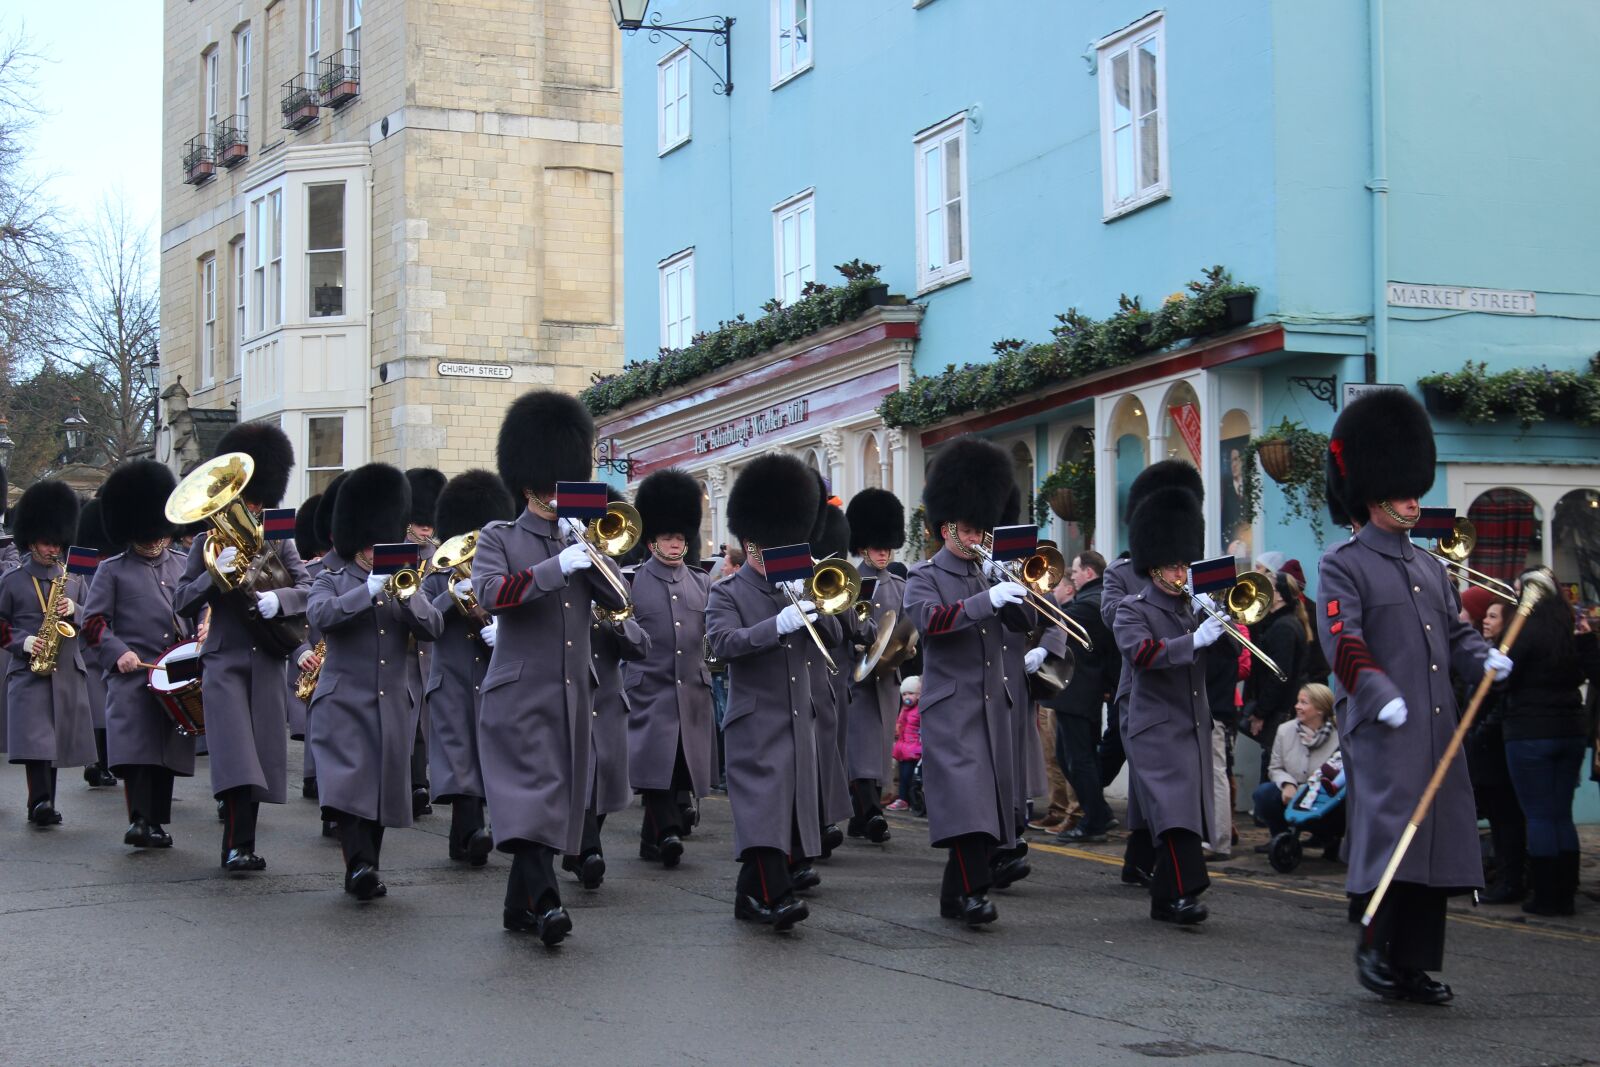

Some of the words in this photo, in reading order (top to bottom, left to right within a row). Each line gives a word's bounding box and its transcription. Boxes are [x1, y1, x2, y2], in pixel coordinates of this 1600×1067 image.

[1392, 288, 1463, 306] MARKET
[1470, 292, 1530, 310] STREET
[441, 364, 475, 374] CHURCH
[478, 367, 509, 376] STREET
[694, 433, 708, 455] The
